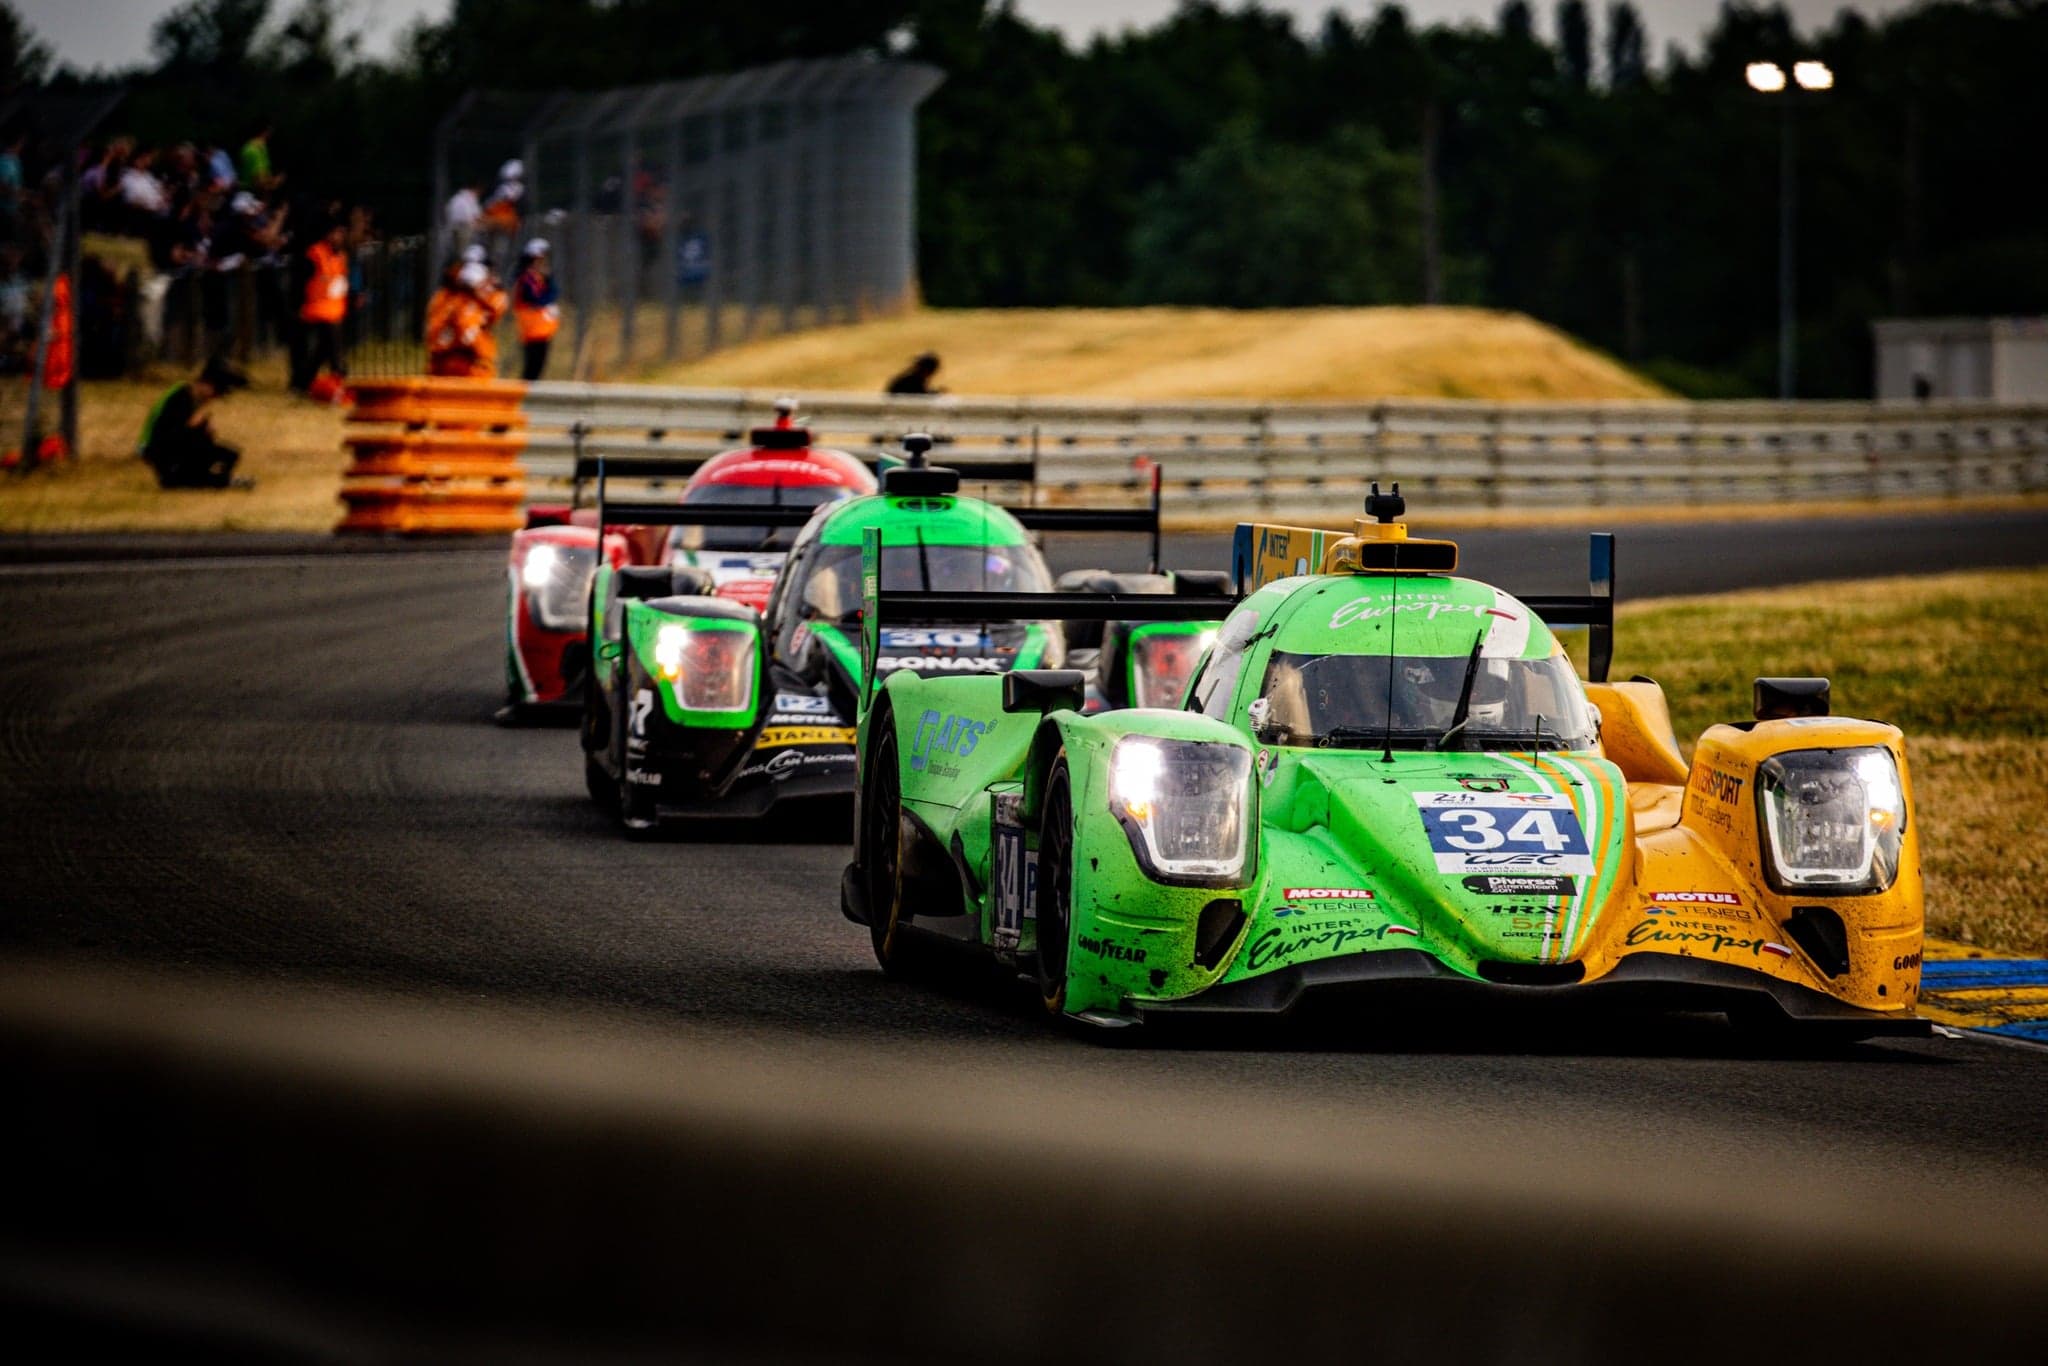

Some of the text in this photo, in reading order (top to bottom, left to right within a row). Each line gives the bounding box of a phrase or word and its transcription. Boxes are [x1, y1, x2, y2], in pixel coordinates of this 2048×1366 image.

[888, 631, 980, 647] 30
[876, 656, 1003, 671] SONAX
[1439, 809, 1570, 851] 34
[1464, 853, 1564, 866] WEC
[1287, 889, 1372, 899] MOTUL
[1655, 892, 1738, 904] MOTUL
[1292, 920, 1353, 934] INTER
[1669, 920, 1729, 934] INTER
[1625, 919, 1765, 956] Europol
[1246, 923, 1391, 970] Europol
